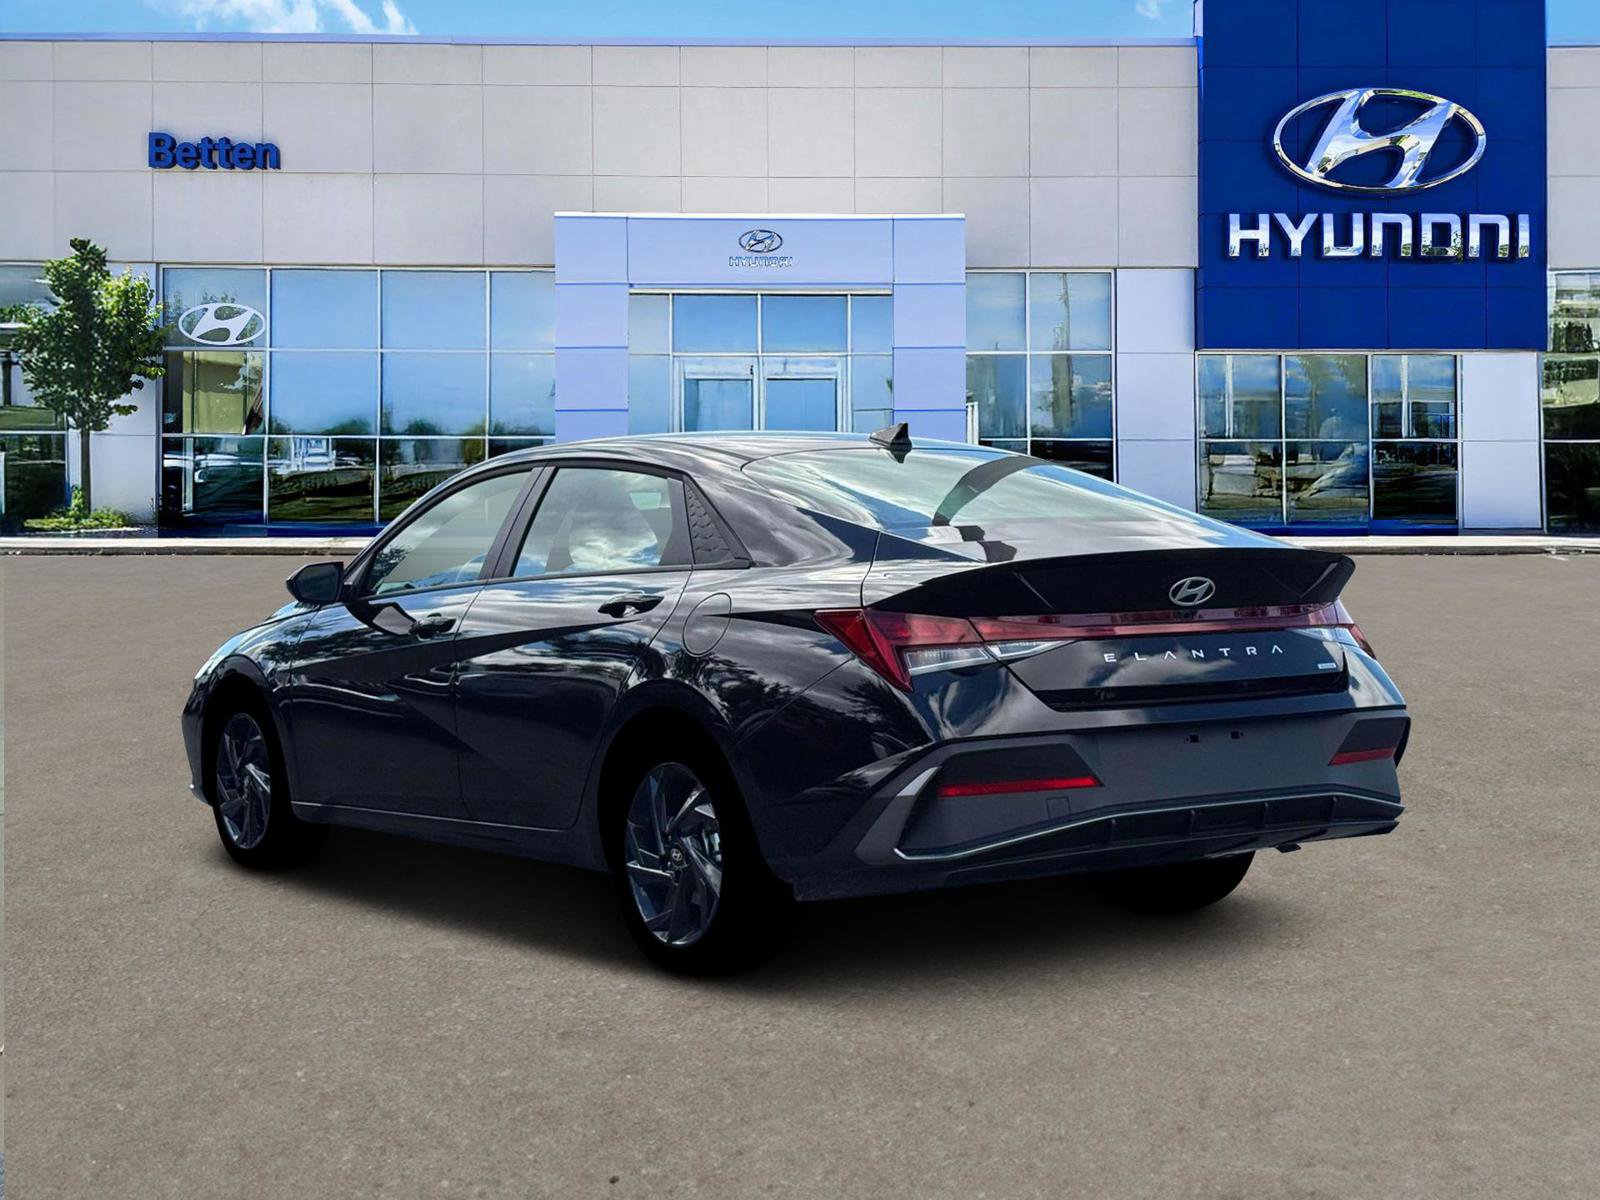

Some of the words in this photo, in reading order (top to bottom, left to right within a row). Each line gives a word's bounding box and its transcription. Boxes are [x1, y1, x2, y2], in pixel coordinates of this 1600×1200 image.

[148, 132, 281, 170] Betten
[728, 256, 794, 268] HYUNDAI
[1103, 644, 1284, 663] ELANTRA
